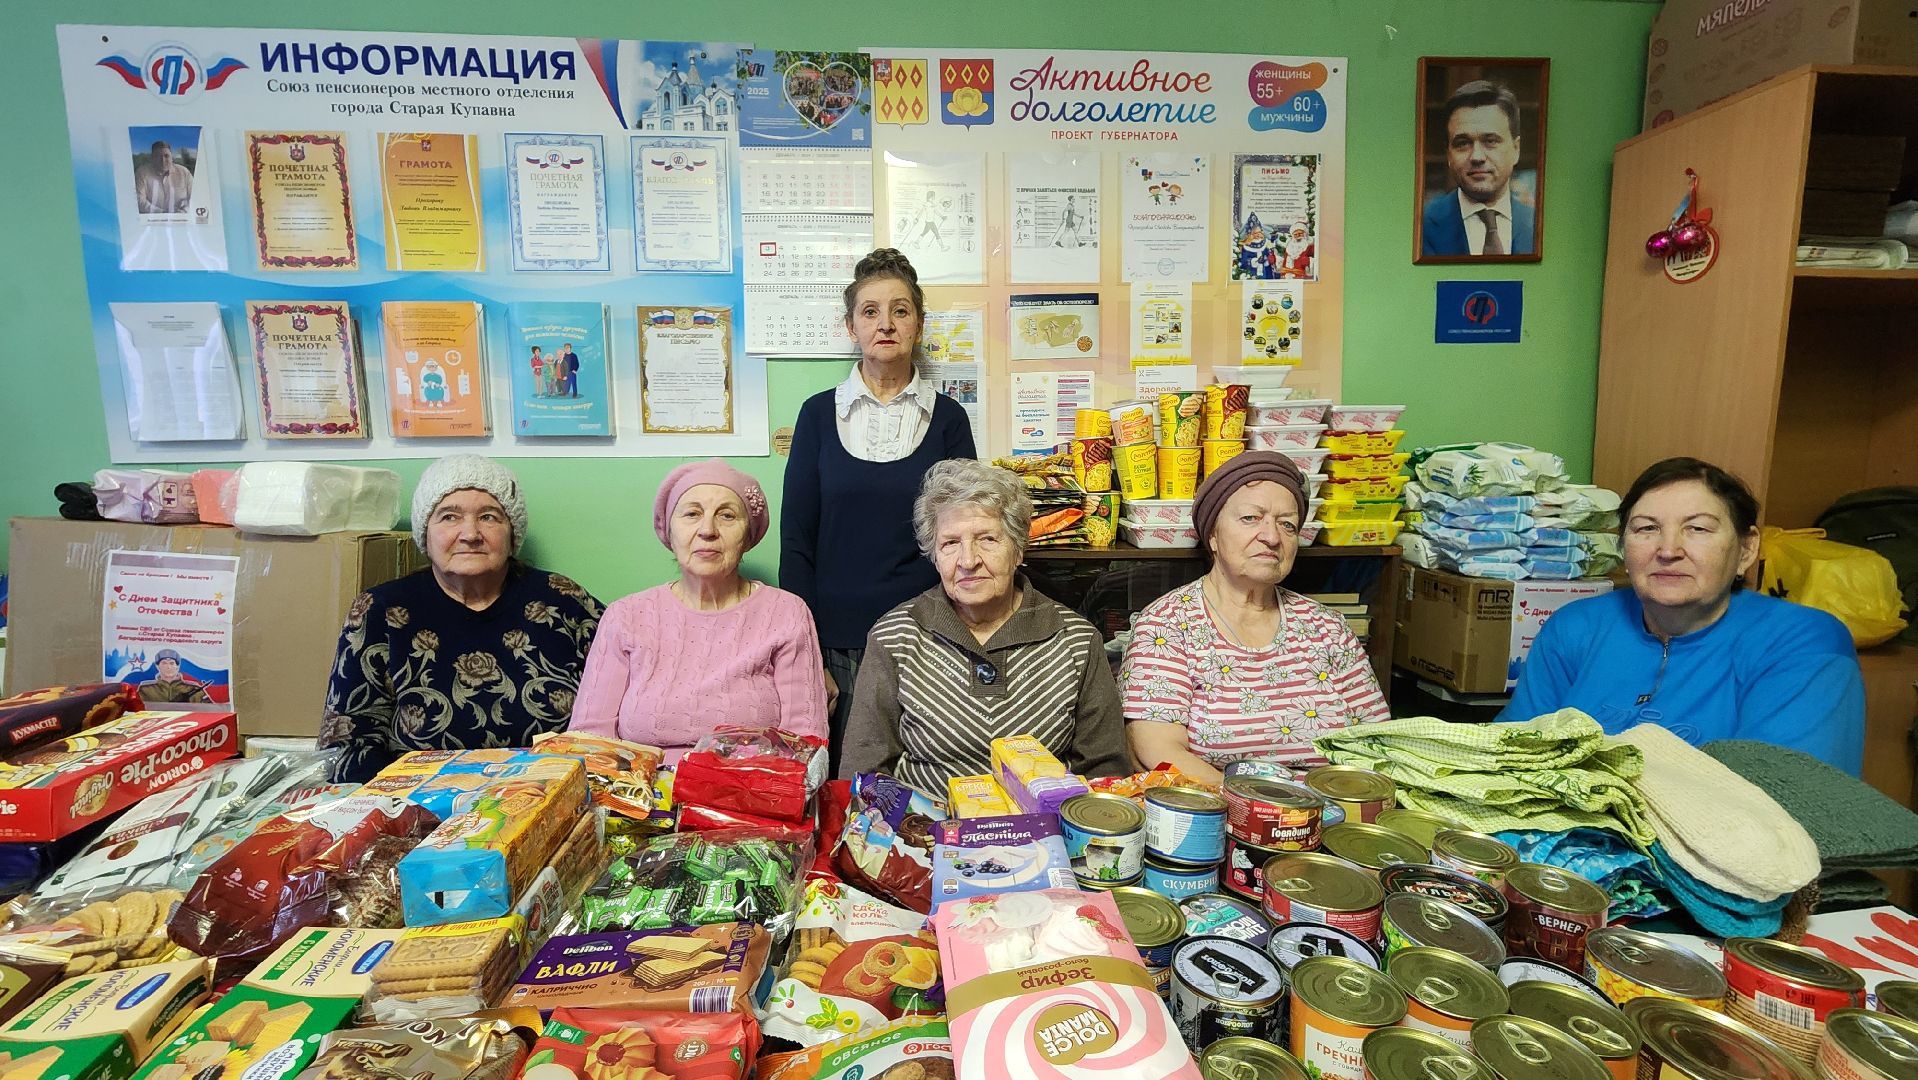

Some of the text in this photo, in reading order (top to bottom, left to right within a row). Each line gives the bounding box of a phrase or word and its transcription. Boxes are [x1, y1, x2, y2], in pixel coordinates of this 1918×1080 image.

[260, 42, 576, 84] ИНФОРМАЦИЯ
[1010, 56, 1213, 93] Активное
[1255, 68, 1311, 80] женщины
[267, 79, 575, 100] Союз пенсионеров местного отделения
[747, 87, 770, 95] 2025
[1256, 83, 1283, 99] 55+
[331, 101, 516, 118] города Старая Купавна
[1010, 87, 1217, 124] долголетие
[1293, 97, 1321, 112] 60+
[1261, 112, 1314, 123] мужчины
[1051, 130, 1178, 142] ПРОЕКТ ГУБЕРНАТОРА
[269, 163, 329, 173] ПОЧЕТНАЯ
[399, 159, 453, 169] ГРАМОТА
[274, 173, 326, 181] ГРАМОТА
[530, 173, 583, 181] ПОЧЕТНАЯ
[536, 181, 580, 190] ГРАМОТА
[273, 333, 332, 342] ПОЧЕТНАЯ
[278, 342, 328, 350] ГРАМОТА
[118, 593, 220, 607] С Днем Защитника
[137, 606, 193, 616] Отечества
[12, 716, 59, 741] КУХМАСТЕР
[69, 769, 115, 819] Original
[1271, 826, 1311, 838] Говядина
[562, 943, 614, 956] Delibon
[535, 960, 618, 980] ВАФЛИ
[1020, 966, 1096, 990] Зефир
[530, 983, 598, 996] КАПРИЧЧИО
[1037, 1008, 1101, 1042] MANIA
[1043, 1021, 1110, 1058] DOLCE
[831, 1032, 902, 1067] ОВСЯНОЕ
